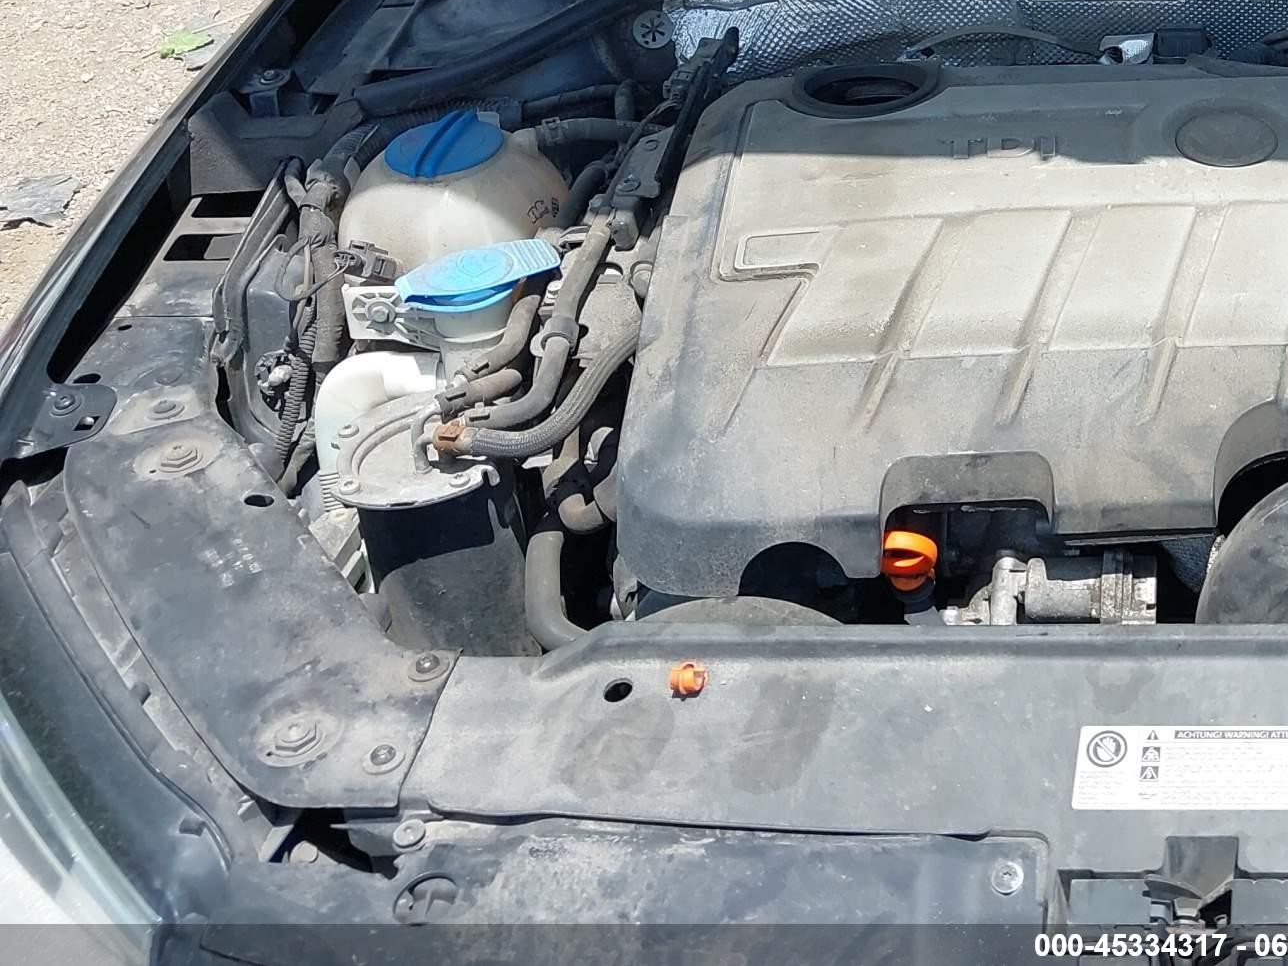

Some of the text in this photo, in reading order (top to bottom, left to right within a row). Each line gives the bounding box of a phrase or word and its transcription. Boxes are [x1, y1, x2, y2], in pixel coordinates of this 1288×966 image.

[939, 135, 1058, 161] TDI
[1177, 730, 1222, 739] ACHTUNG!
[1224, 730, 1269, 739] WARNING!
